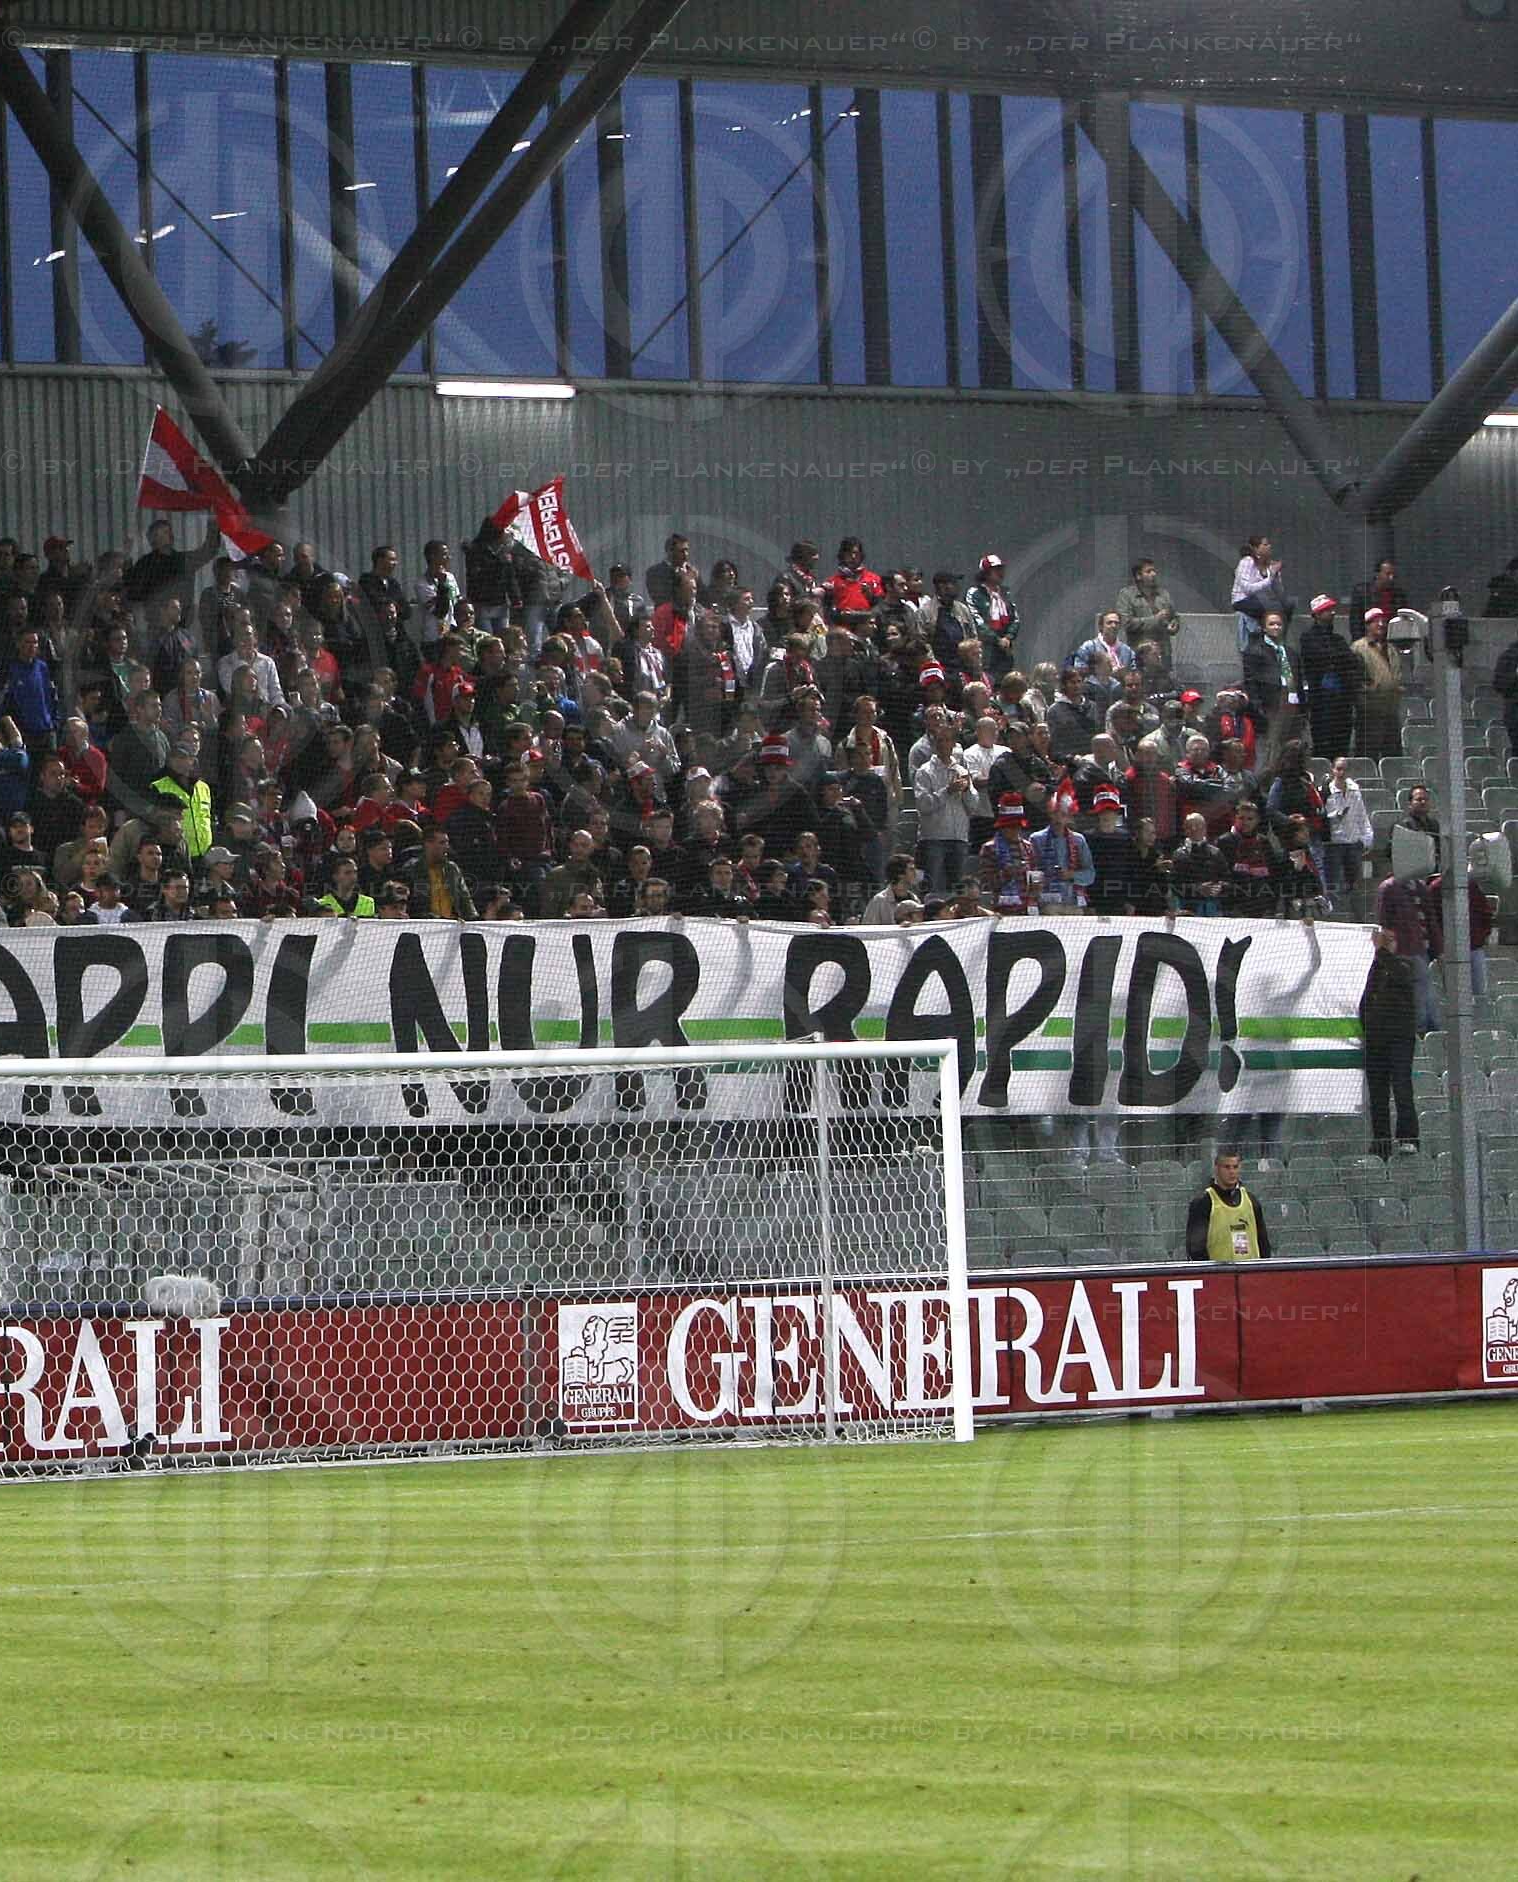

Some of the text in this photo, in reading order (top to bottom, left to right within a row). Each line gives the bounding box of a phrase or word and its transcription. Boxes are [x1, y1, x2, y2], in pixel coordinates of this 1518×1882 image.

[389, 931, 709, 1118] NUR
[783, 930, 1253, 1111] RAPID!
[563, 1386, 632, 1406] GENERALI
[667, 1280, 1205, 1422] GENERALI
